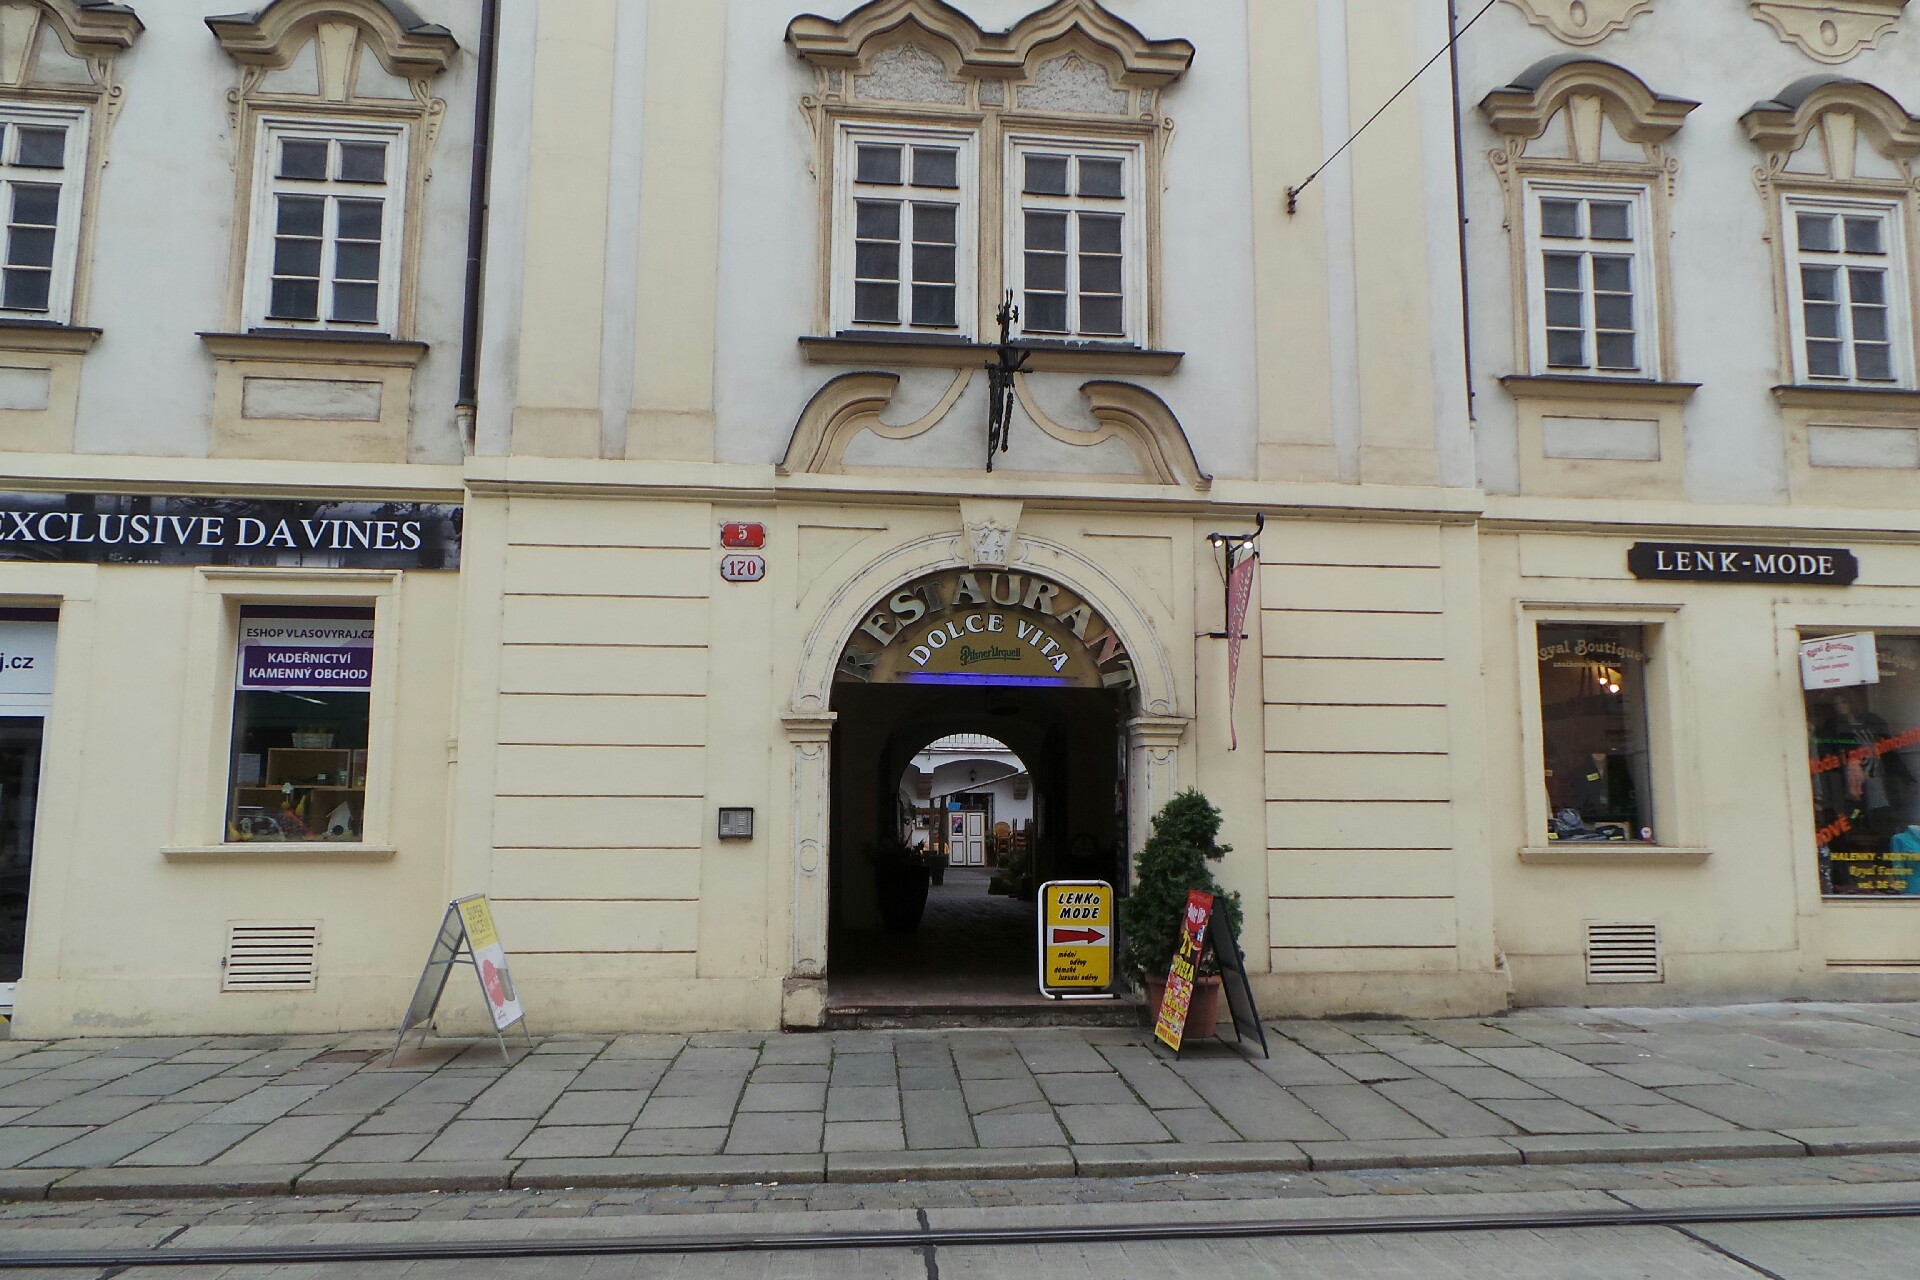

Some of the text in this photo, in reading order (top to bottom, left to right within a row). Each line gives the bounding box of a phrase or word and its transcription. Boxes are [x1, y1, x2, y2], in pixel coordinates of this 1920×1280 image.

[0, 511, 225, 546] XCLUSIVE
[738, 525, 748, 540] 5
[729, 560, 757, 576] 170
[1656, 550, 1835, 576] LENK-MODE
[246, 628, 374, 639] ESHOP VLASOVYRAJ.CZ
[836, 573, 1137, 689] RESTAURANT
[908, 613, 1071, 673] DOLCE VITA
[1574, 639, 1643, 661] Boutique
[267, 651, 352, 664] KADEŘNICTVÍ
[960, 644, 1021, 666] Pilsner Urquell
[249, 667, 368, 679] KAMENNÝ OBCHOD
[1059, 907, 1101, 919] MODE
[1173, 957, 1195, 984] PIZZA
